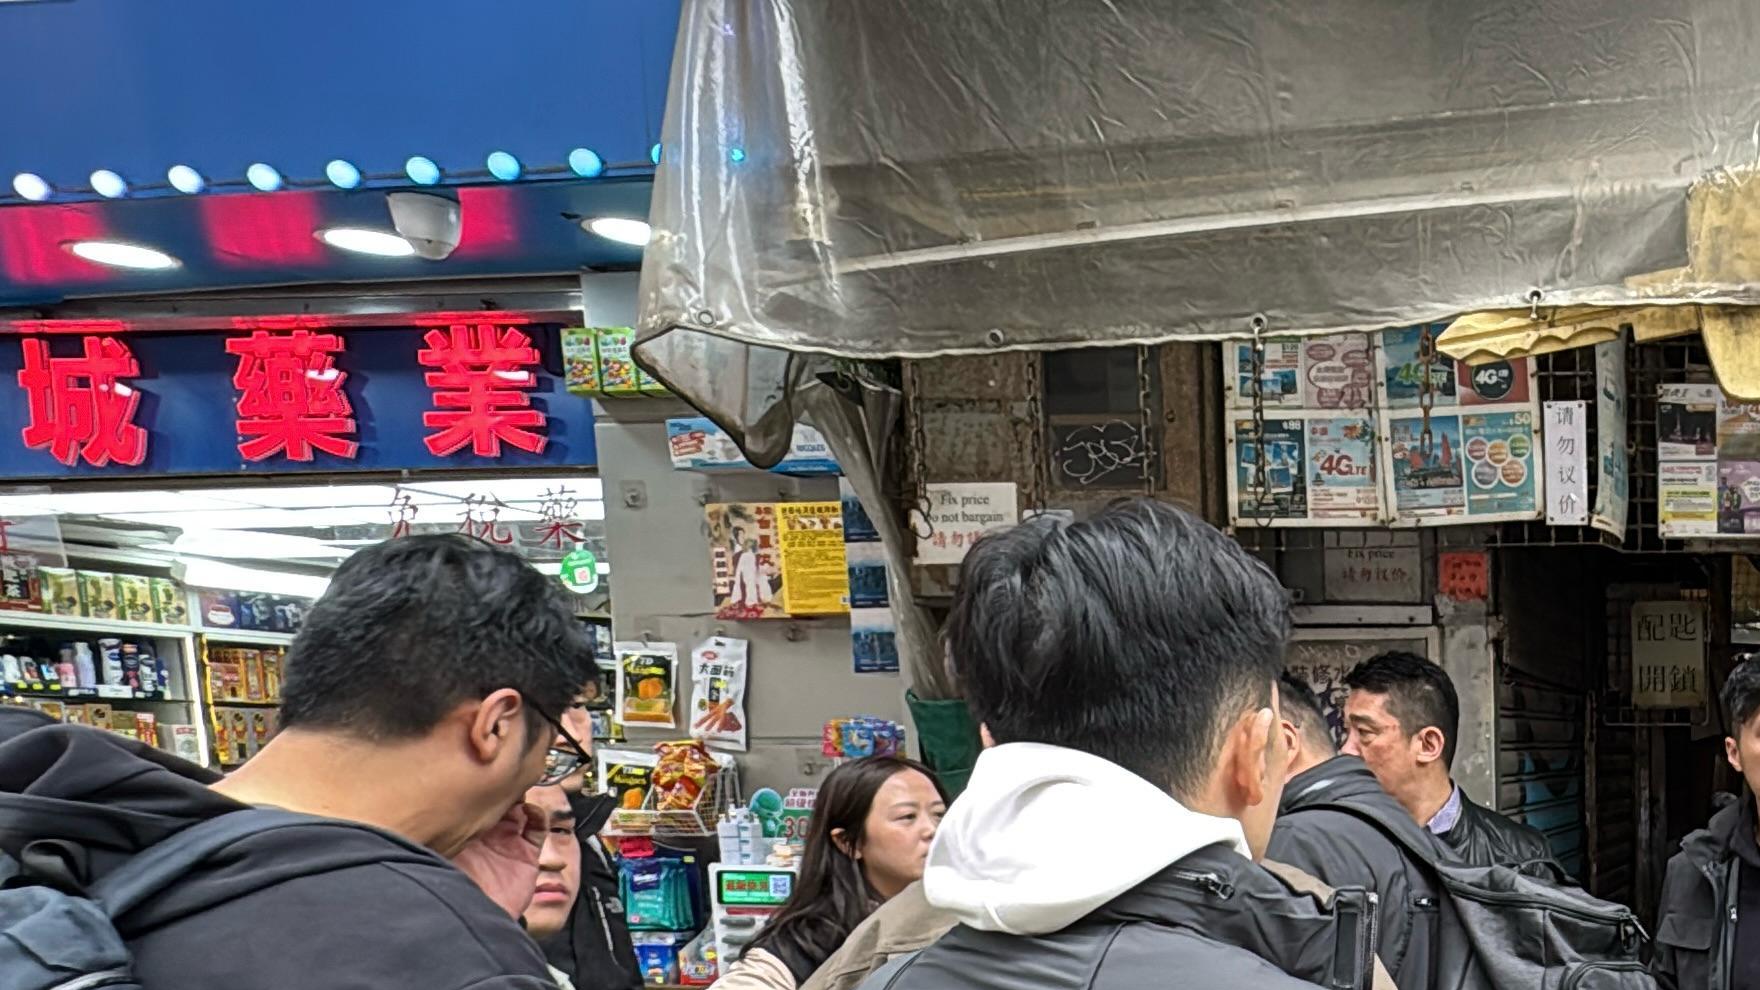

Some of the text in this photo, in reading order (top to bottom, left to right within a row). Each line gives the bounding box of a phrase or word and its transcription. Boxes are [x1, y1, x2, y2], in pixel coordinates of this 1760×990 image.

[1475, 369, 1498, 385] 4G
[18, 327, 547, 467] 城藥業
[1556, 406, 1578, 517] 请勿议价
[941, 494, 990, 508] Fix price
[941, 513, 959, 523] not
[961, 511, 1004, 526] bargain
[1636, 612, 1697, 643] 配匙
[1638, 663, 1699, 695] 開鎖
